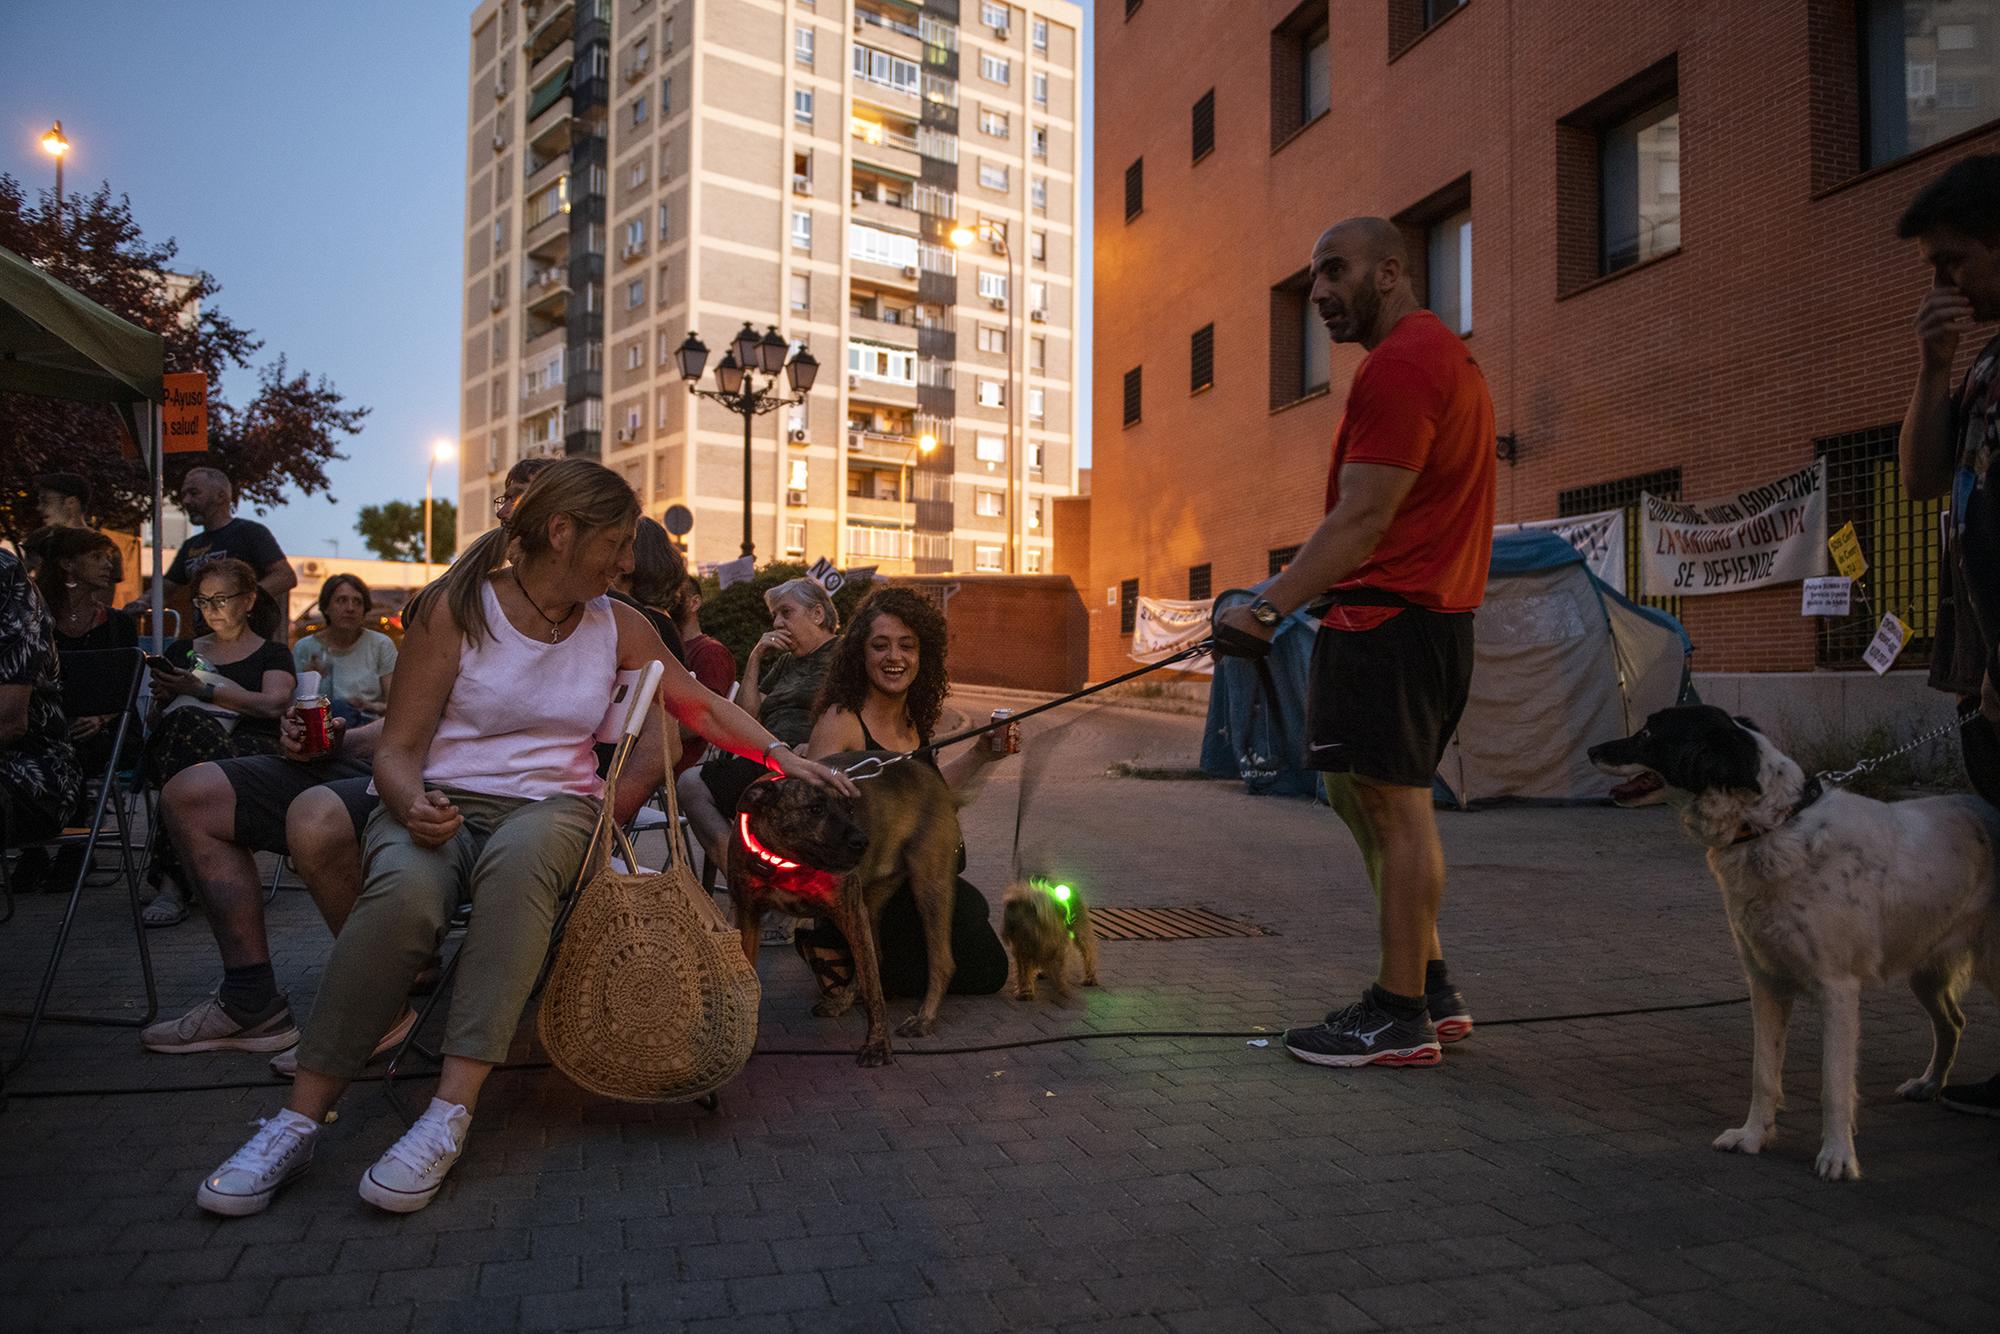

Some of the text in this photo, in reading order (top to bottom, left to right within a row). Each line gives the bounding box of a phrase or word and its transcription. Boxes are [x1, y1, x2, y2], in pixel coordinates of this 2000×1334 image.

[171, 415, 199, 436] salud!
[1704, 503, 1743, 525] QUIEN
[811, 557, 842, 592] NO
[1674, 548, 1779, 588] SE DEFIENDE
